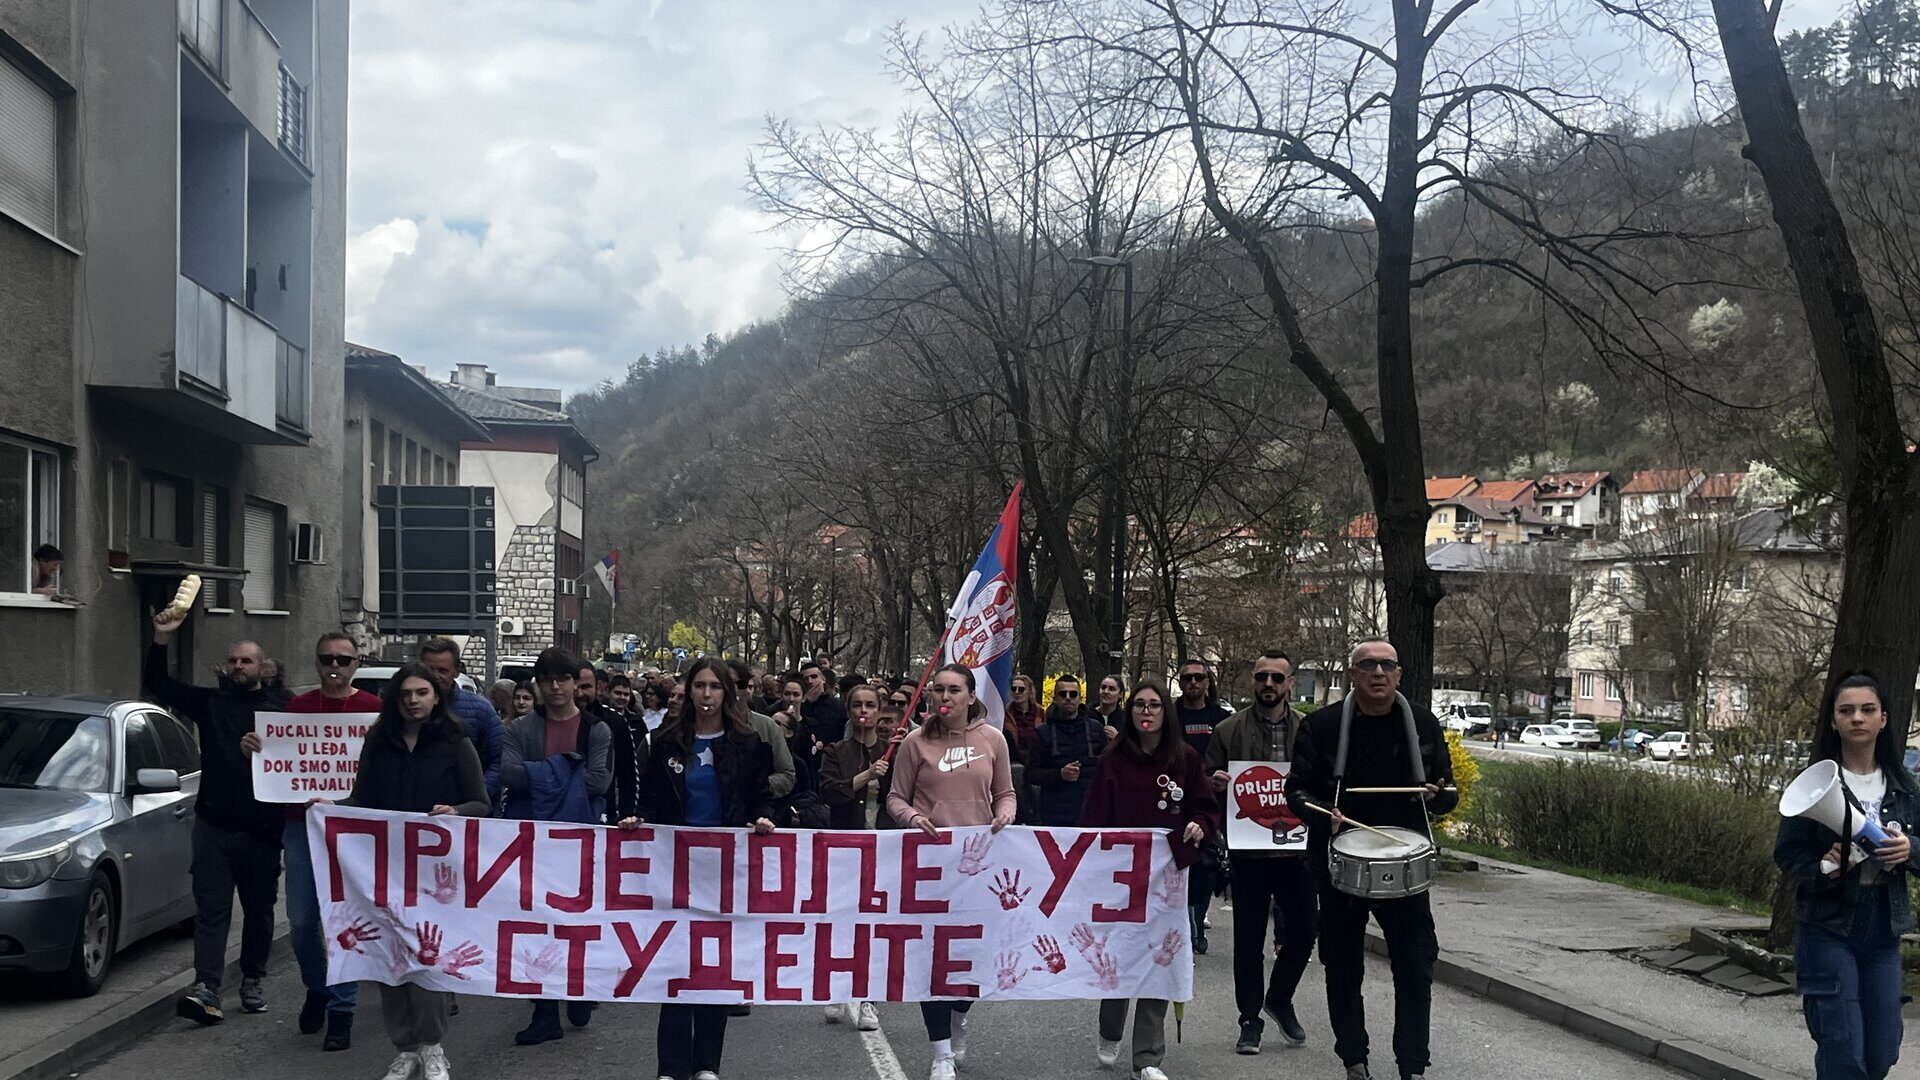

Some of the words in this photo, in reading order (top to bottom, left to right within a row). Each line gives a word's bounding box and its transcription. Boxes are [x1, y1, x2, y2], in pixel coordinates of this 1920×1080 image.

[266, 724, 318, 738] PUCALI
[324, 724, 343, 738] SU
[348, 725, 372, 738] NA
[298, 742, 307, 756] U
[313, 742, 348, 756] LEĐA
[944, 746, 975, 761] NIKE
[263, 759, 293, 773] DOK
[299, 759, 331, 774] SMO
[336, 760, 361, 773] MIR
[1258, 793, 1288, 807] PUM
[324, 816, 952, 915] ПРИЈЕПОЉЕ
[1033, 831, 1154, 924] УЗ
[495, 919, 983, 1002] СТУДЕНТЕ
